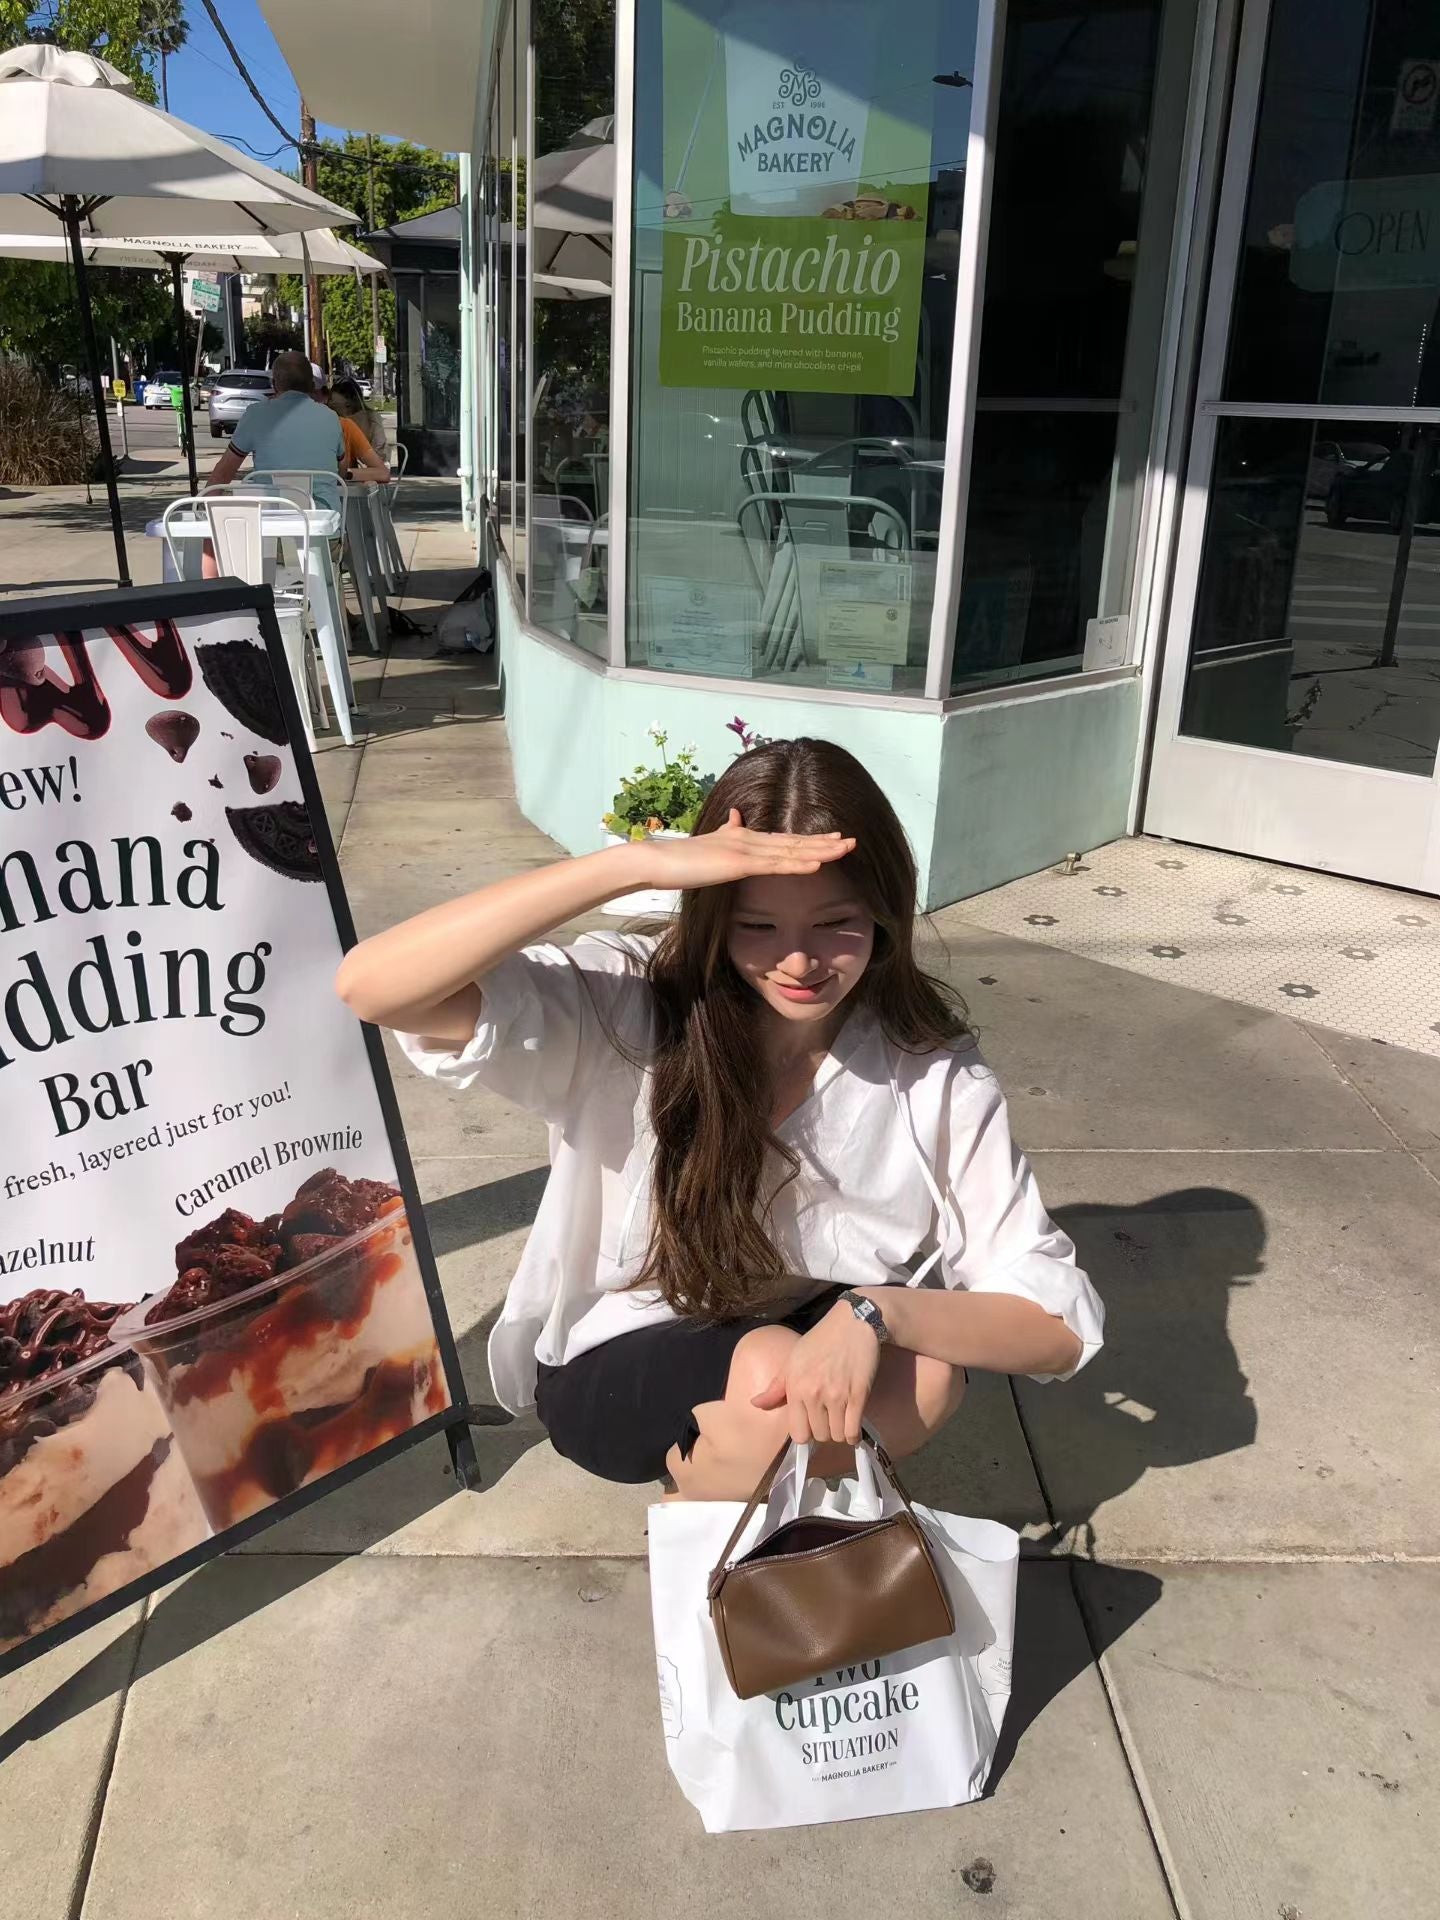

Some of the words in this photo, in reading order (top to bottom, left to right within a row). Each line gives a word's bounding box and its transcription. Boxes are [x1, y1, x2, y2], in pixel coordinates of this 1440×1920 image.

[737, 113, 856, 163] MAGNOLIA
[757, 152, 835, 173] BAKERY
[123, 237, 191, 249] MAGNOLIA
[195, 243, 241, 251] BAKERY
[1334, 210, 1431, 256] OPEN
[677, 234, 901, 296] Pistachio
[676, 302, 773, 333] Banana
[780, 302, 901, 343] Pudding
[702, 345, 738, 354] Pistachio
[738, 345, 771, 358] pudding
[772, 347, 804, 359] layered
[805, 348, 824, 357] with
[703, 358, 727, 368] vanilla
[757, 359, 773, 368] and
[793, 360, 836, 371] chocolate
[0, 930, 273, 1069] dding
[39, 1058, 153, 1137] Bar
[3, 1161, 76, 1199] fresh,
[78, 1127, 163, 1172] layered
[166, 1113, 209, 1148] just
[212, 1103, 245, 1126] for
[249, 1081, 292, 1118] you!
[175, 1146, 273, 1217] Caramel
[273, 1125, 364, 1168] Brownie
[775, 1679, 919, 1734] Cupcake
[802, 1728, 898, 1765] SITUATION
[821, 1768, 861, 1782] MAGNOLIA
[862, 1761, 889, 1775] BAKERY
